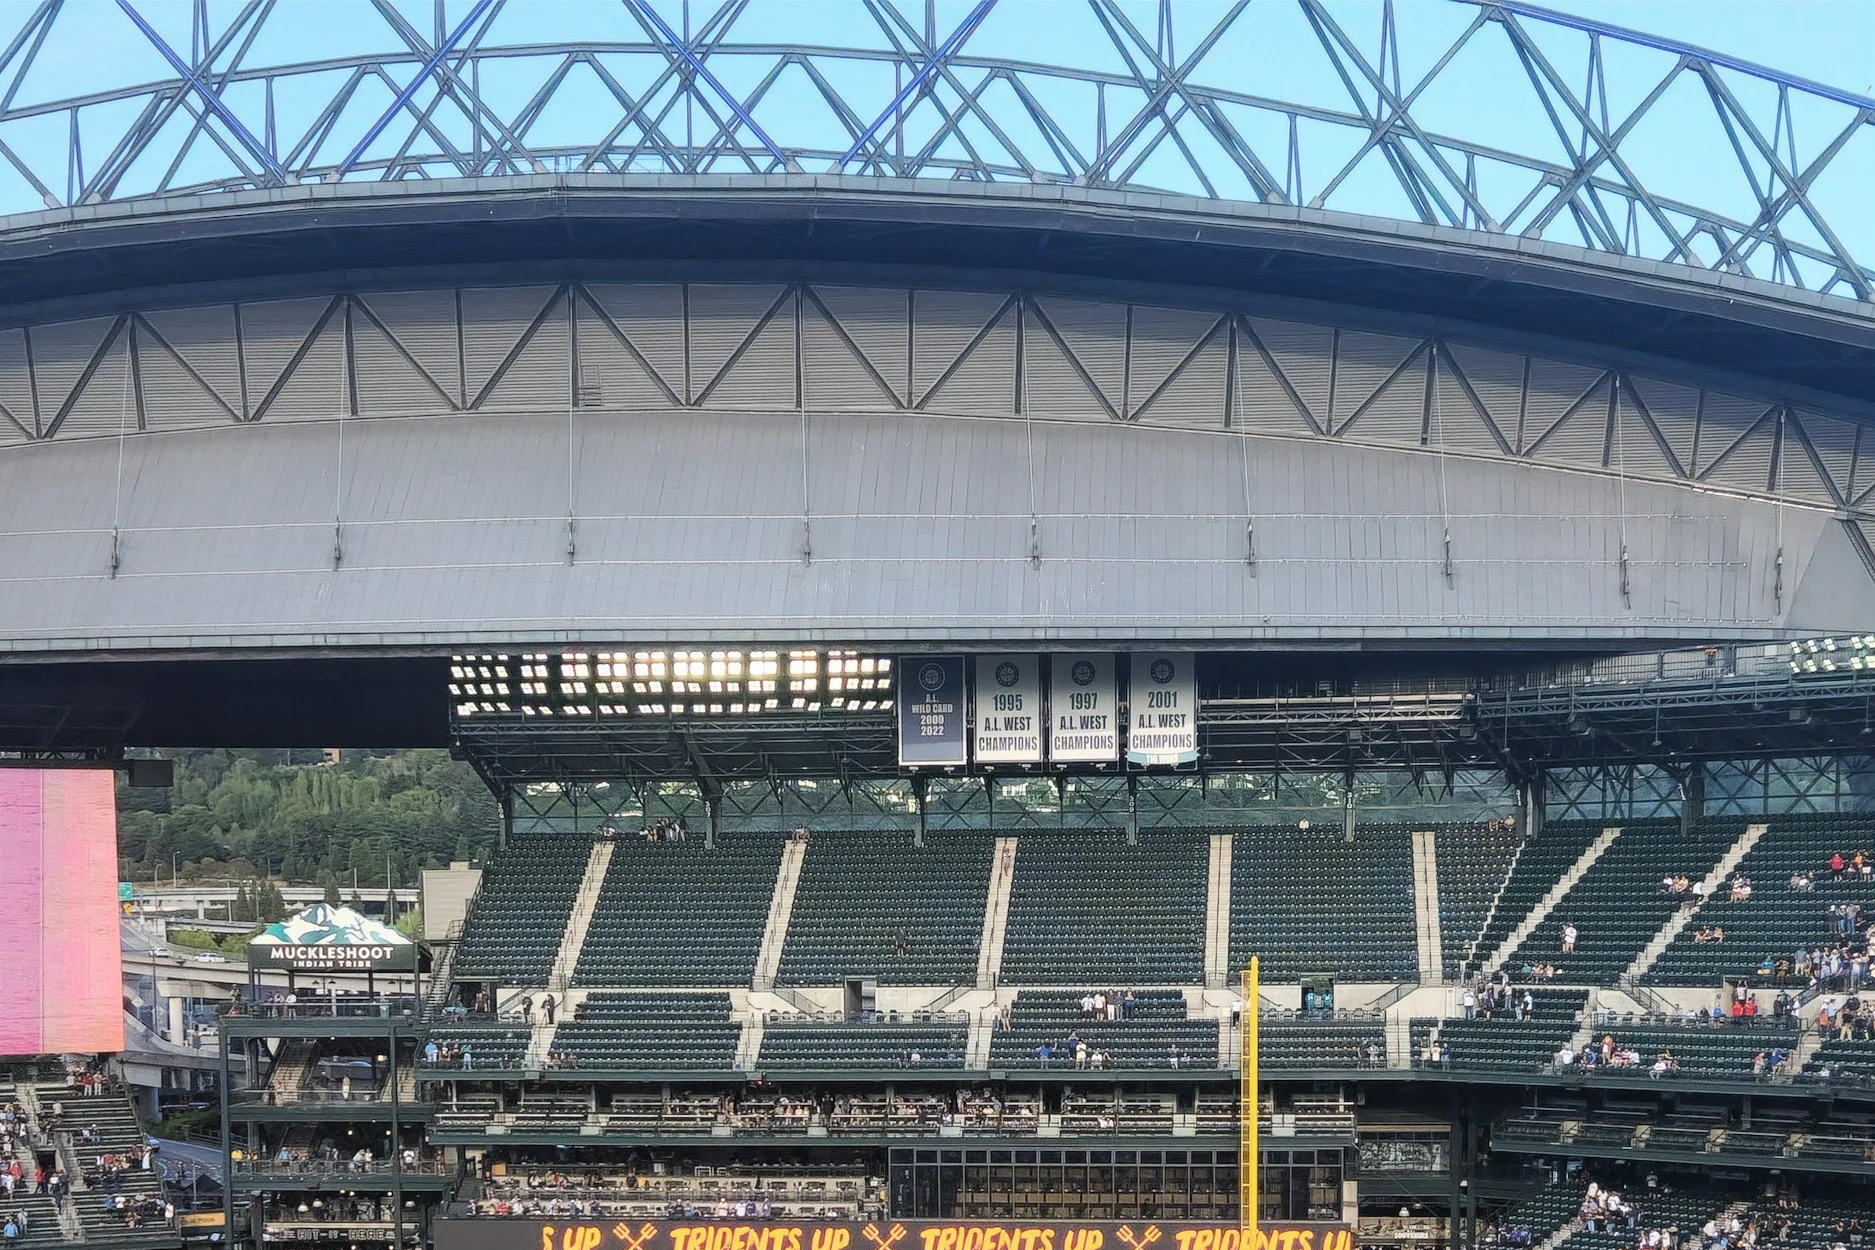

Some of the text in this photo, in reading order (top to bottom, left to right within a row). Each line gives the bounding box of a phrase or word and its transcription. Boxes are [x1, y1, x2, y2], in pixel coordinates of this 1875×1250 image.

[926, 694, 939, 703] A.L.
[993, 694, 1023, 711] 1995
[1069, 692, 1098, 710] 1997
[1148, 691, 1177, 708] 2001
[911, 703, 953, 714] WILD CARD
[920, 714, 944, 725] 2000
[984, 717, 1031, 731] A.L. WEST
[1060, 716, 1107, 730] A.L. WEST
[1138, 714, 1186, 729] A.L. WEST
[921, 726, 944, 736] 2022
[979, 737, 1038, 751] CHAMPIONS
[1054, 735, 1113, 750] CHAMPIONS
[1132, 734, 1192, 749] CHAMPIONS
[270, 947, 394, 959] MUCKLESHOOT
